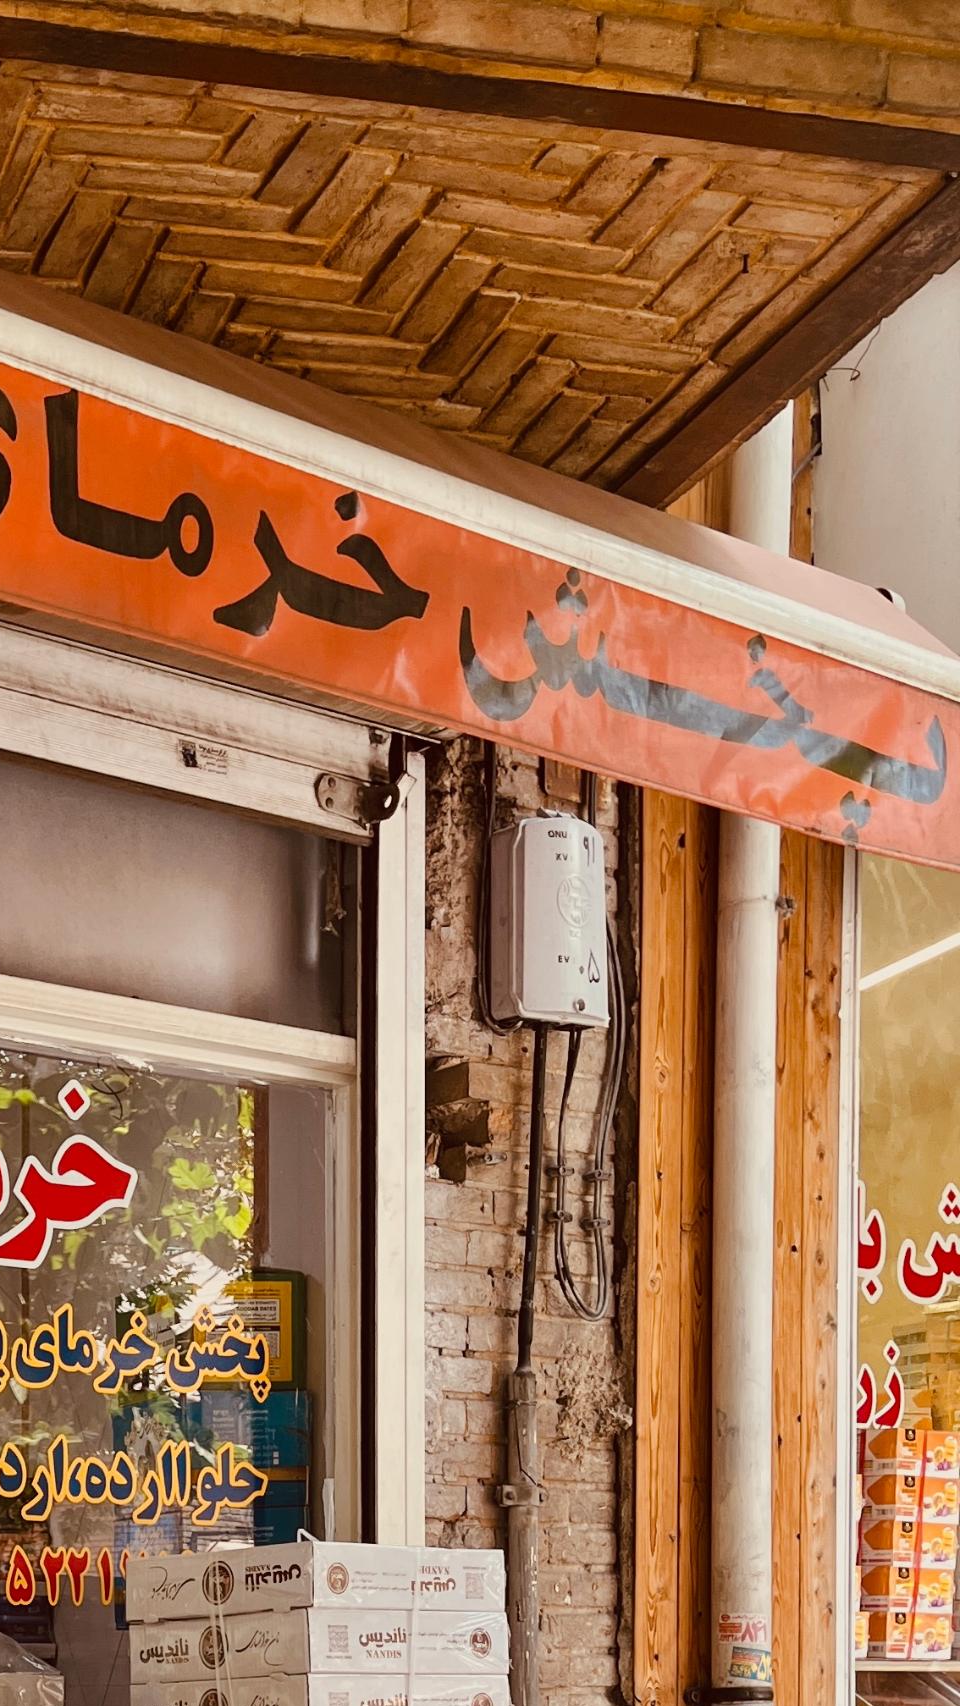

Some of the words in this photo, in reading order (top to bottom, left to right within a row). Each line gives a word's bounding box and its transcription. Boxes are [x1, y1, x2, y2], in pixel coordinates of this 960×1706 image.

[459, 566, 949, 848] پخش
[14, 1303, 159, 1393] خرمای
[165, 1304, 271, 1403] پخش
[420, 1565, 450, 1576] NANDI
[411, 1576, 456, 1597] نندیس
[359, 1627, 407, 1647] ناندیس
[140, 1637, 189, 1664] ناندیس
[366, 1650, 402, 1659] NANDIS
